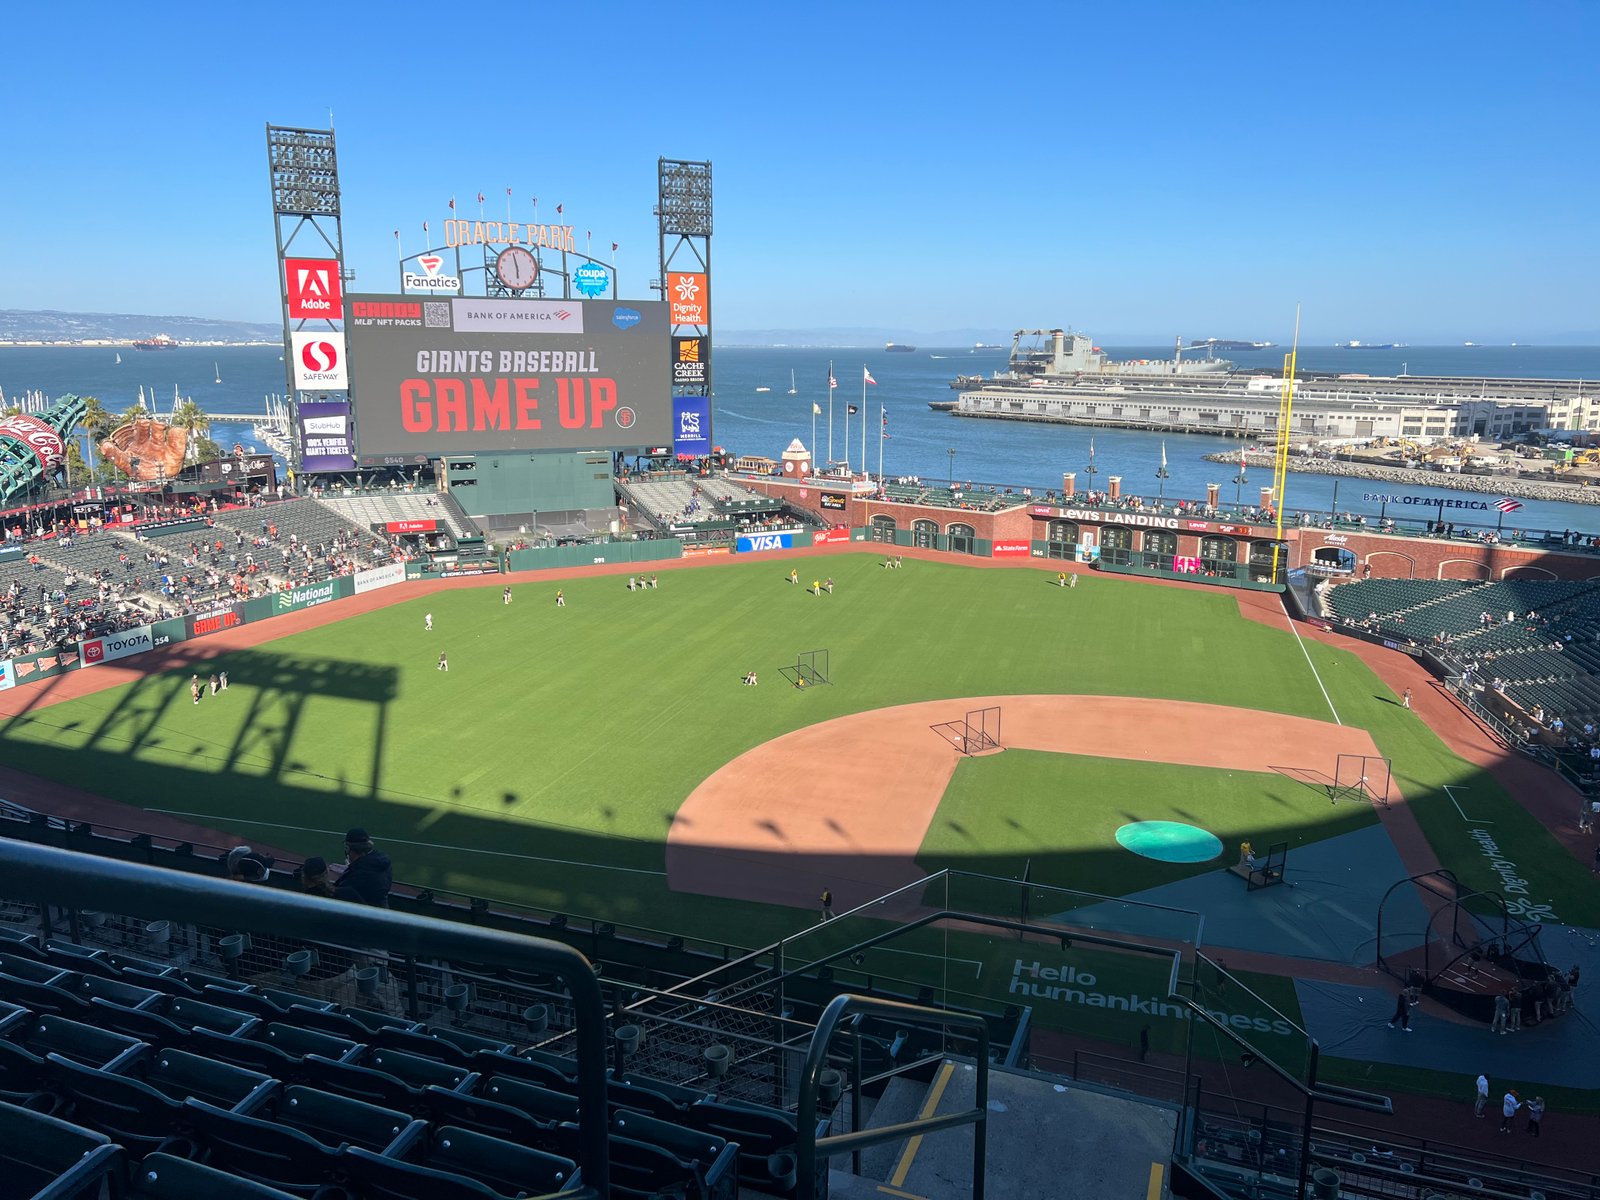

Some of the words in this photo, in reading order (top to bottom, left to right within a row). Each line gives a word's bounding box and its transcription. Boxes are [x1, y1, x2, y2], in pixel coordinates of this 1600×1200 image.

[444, 219, 520, 247] ORACLE
[527, 224, 576, 253] PARK
[578, 269, 606, 280] coupa
[406, 275, 458, 288] Fanatics
[301, 298, 331, 310] Adobe
[673, 303, 702, 314] Dignity
[467, 312, 494, 320] BANK
[496, 312, 508, 320] OF
[509, 312, 552, 321] AMERICA
[416, 350, 492, 373] GIANTS
[499, 350, 599, 373] BASEBALL
[674, 362, 705, 370] CACHE
[303, 373, 339, 381] SAFEWAY
[675, 369, 704, 377] CREEK
[400, 378, 542, 433] GAME
[555, 377, 618, 429] UP
[310, 422, 341, 430] StubHub
[306, 438, 322, 447] 100%
[322, 437, 347, 446] VERIFIED
[305, 446, 326, 456] GIANTS
[326, 446, 349, 455] TICKETS
[1363, 493, 1399, 504] BANK
[1403, 496, 1421, 504] OF
[1424, 498, 1488, 510] AMERICA
[1104, 512, 1179, 529] LANDING
[748, 535, 783, 551] VISA
[357, 578, 368, 586] BANK
[375, 572, 395, 582] AMERICA
[407, 572, 421, 580] 399
[292, 583, 333, 604] National
[193, 617, 221, 635] GAME
[223, 612, 237, 627] UP
[107, 634, 149, 652] TOYOTA
[154, 635, 169, 646] 354
[1013, 958, 1096, 986] Hello
